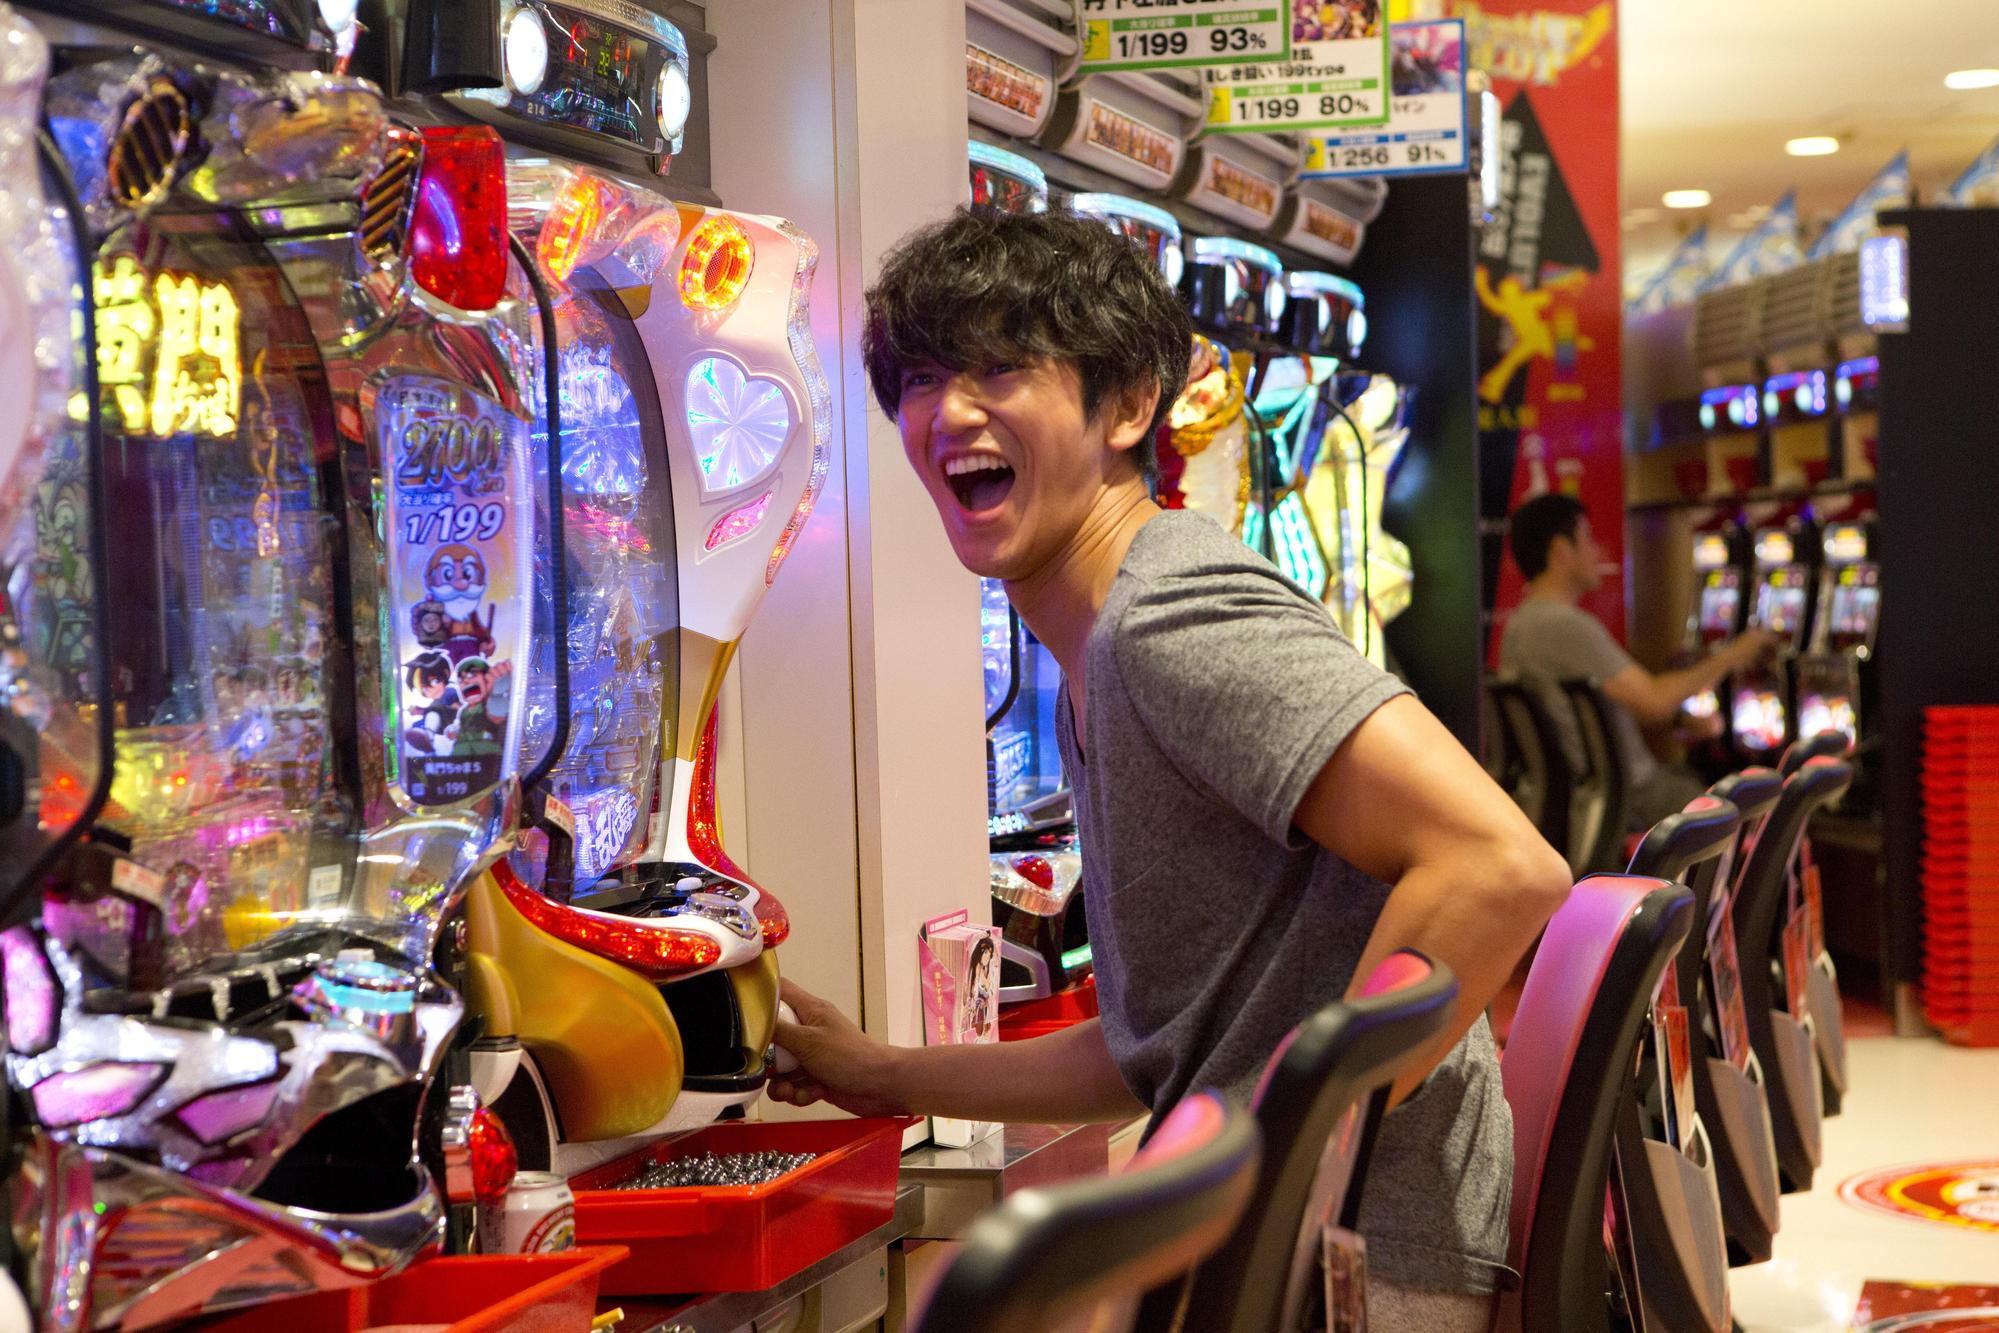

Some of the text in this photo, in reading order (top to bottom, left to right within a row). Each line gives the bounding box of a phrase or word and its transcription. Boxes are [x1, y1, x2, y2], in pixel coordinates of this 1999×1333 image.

[1118, 31, 1188, 58] 1/199
[1210, 27, 1267, 52] 93%
[527, 101, 546, 116] 214
[1238, 98, 1299, 120] 1/199
[1320, 95, 1369, 116] 80%
[1407, 144, 1446, 163] 91%
[406, 502, 506, 545] 1/199
